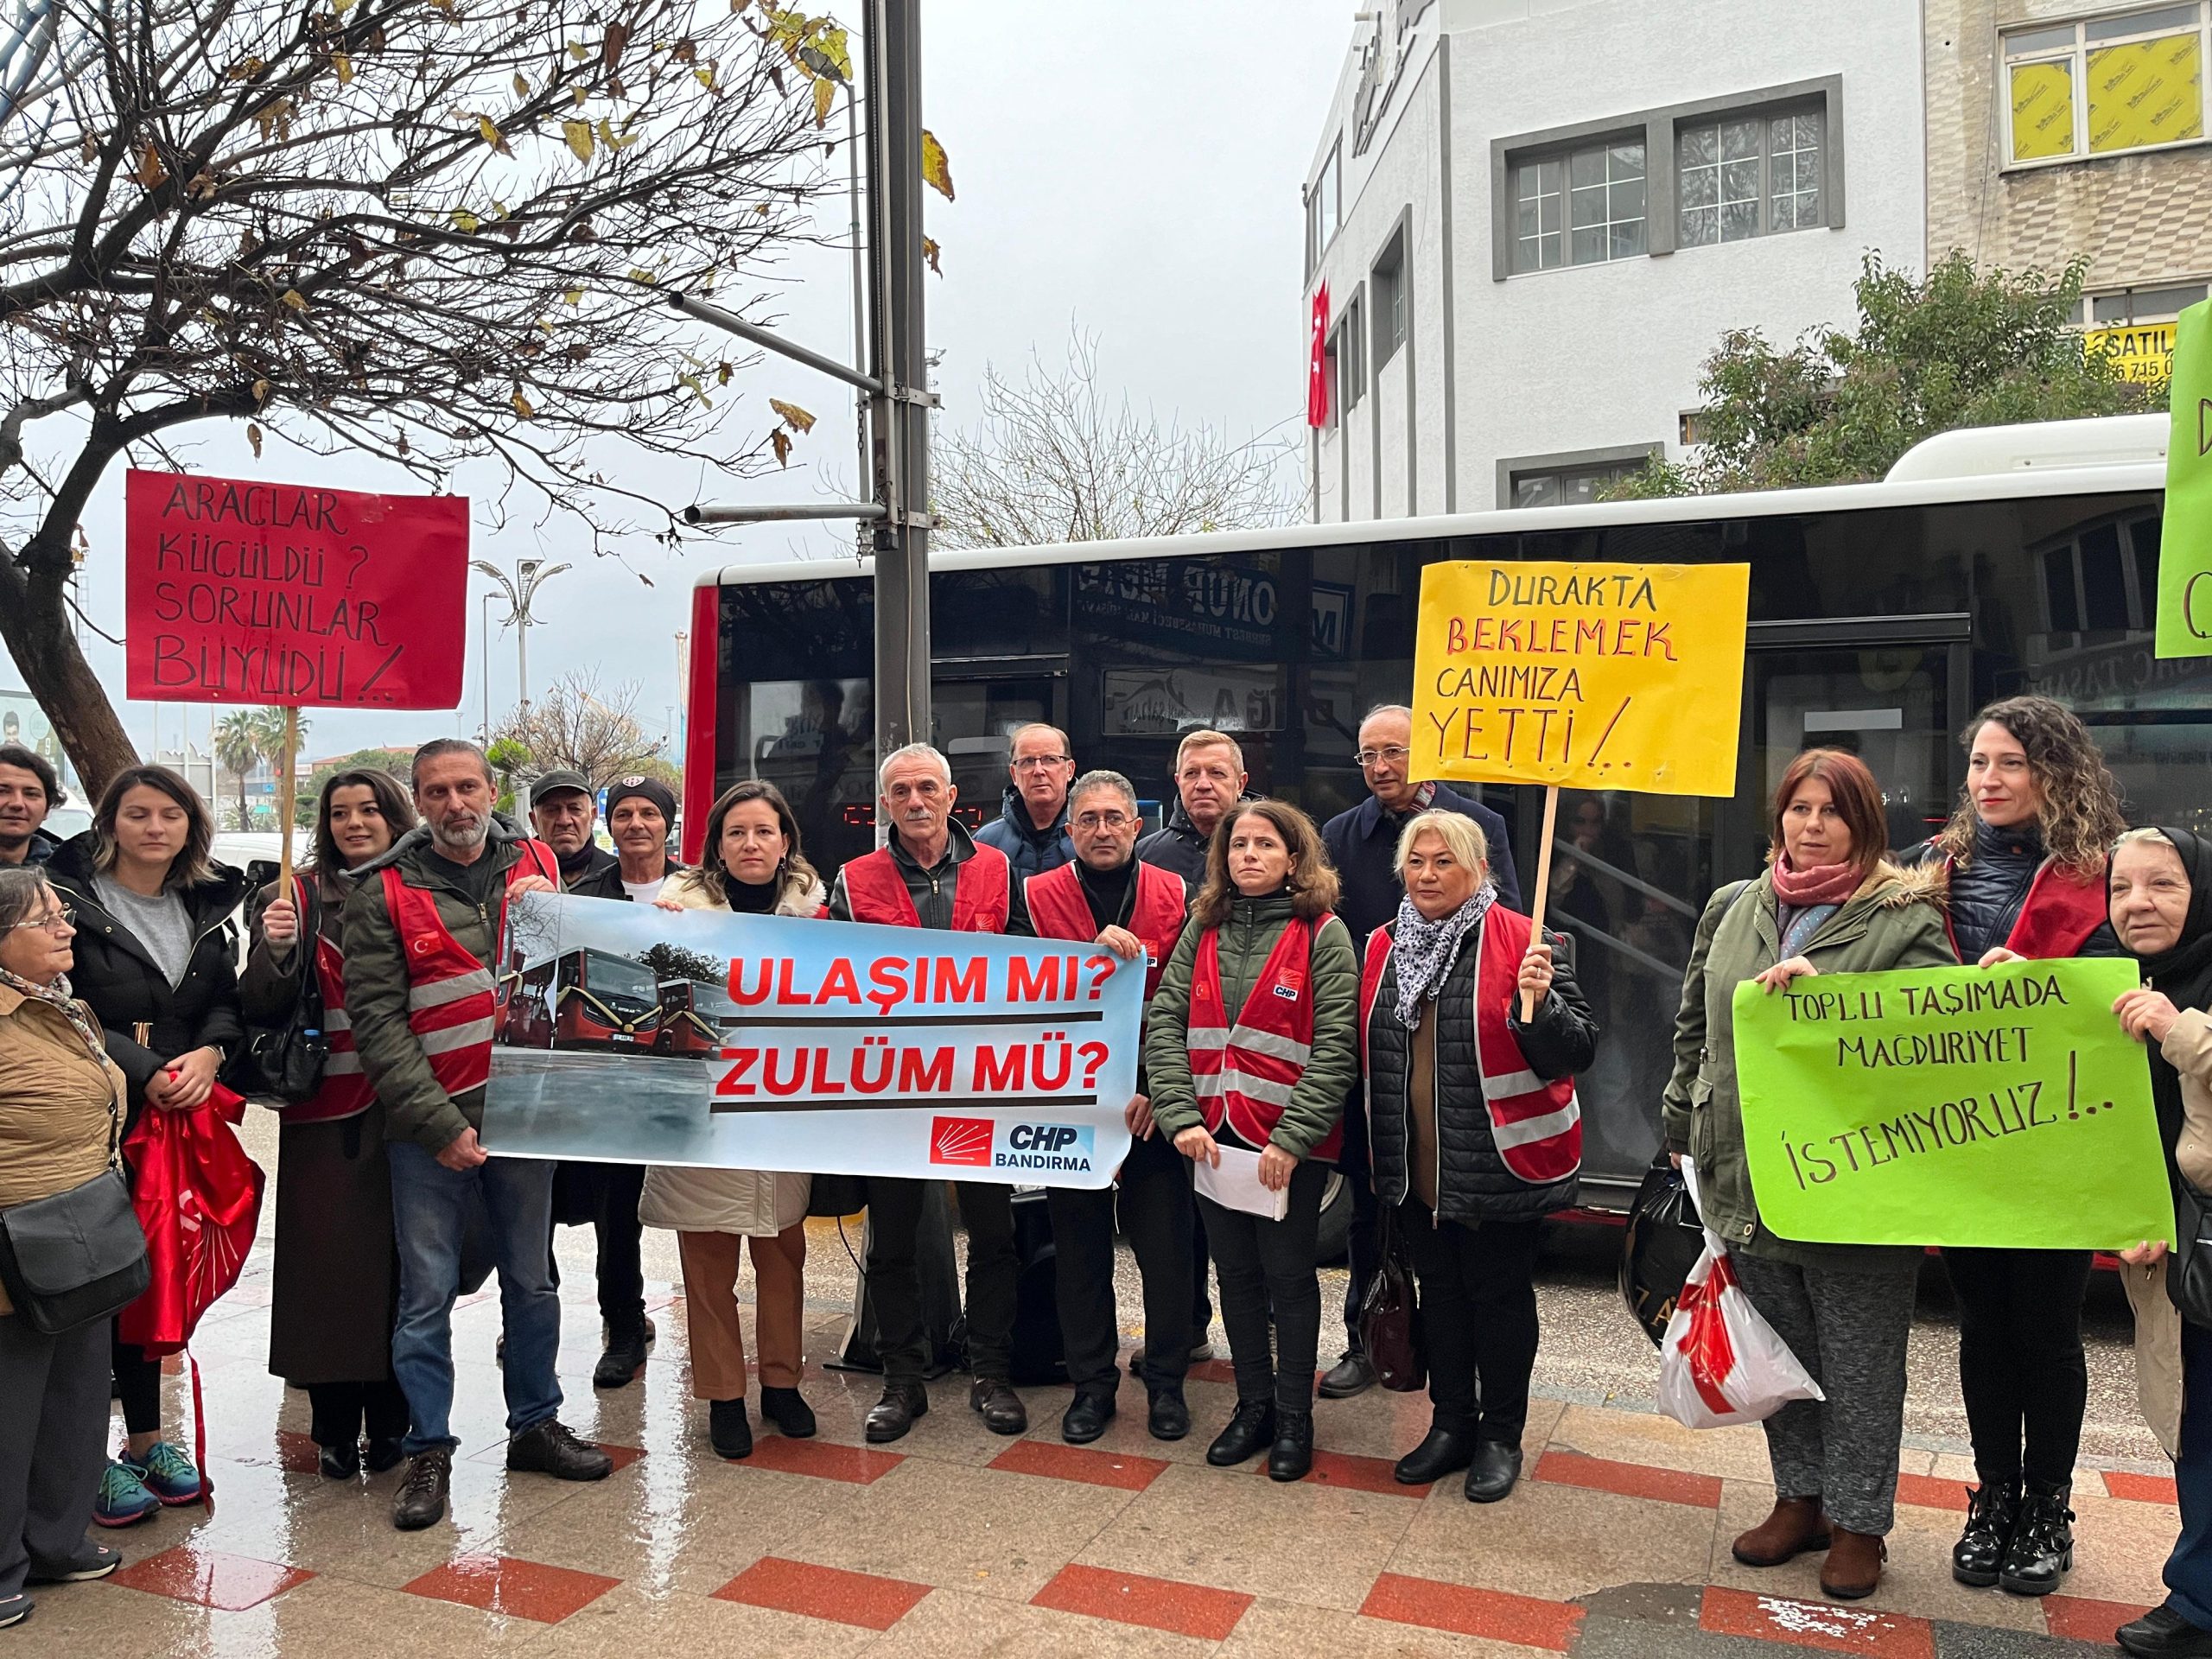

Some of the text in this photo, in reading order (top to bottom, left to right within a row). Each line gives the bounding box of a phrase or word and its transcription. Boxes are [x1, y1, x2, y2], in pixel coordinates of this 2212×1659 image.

[2106, 329, 2176, 357] SATIL
[2131, 361, 2158, 378] 715
[1489, 569, 1657, 612] DURAKTA
[156, 582, 389, 646] SORUNLAR
[1446, 616, 1678, 662] BEKLEMEK
[1436, 665, 1584, 702] CANIMIZA
[727, 954, 1116, 1016] ULAŞIM MI?
[1274, 986, 1296, 998] CHP
[1783, 974, 2069, 1021] TOPLU TAŞIMADA
[715, 1031, 1109, 1096] ZULÜM MÜ?
[1009, 1124, 1077, 1153] CHP
[995, 1152, 1092, 1173] BANDIRMA
